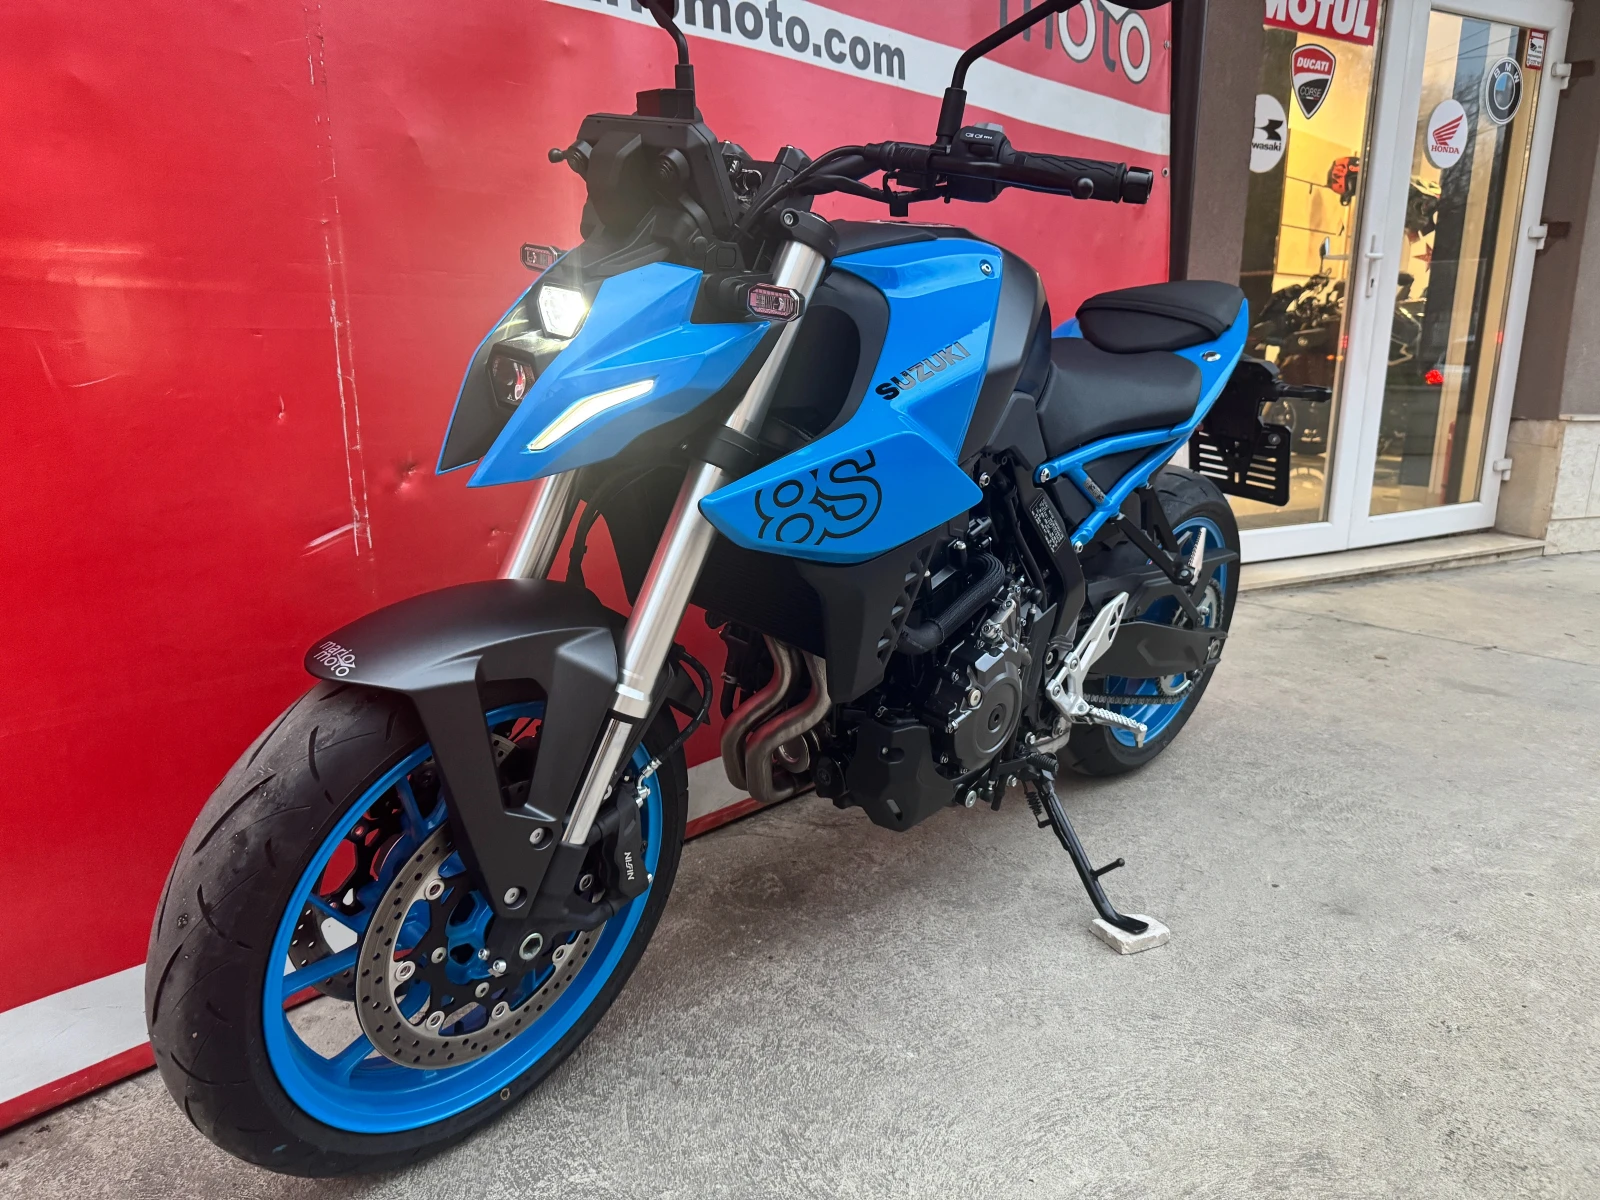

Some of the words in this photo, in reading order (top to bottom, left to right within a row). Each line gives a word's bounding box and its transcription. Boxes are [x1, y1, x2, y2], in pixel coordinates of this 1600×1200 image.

[590, 0, 906, 81] moto.com
[1297, 57, 1330, 72] DUCATI
[1493, 62, 1520, 84] BMW
[1300, 86, 1323, 98] CORSE
[1252, 141, 1282, 151] wasaki
[1431, 144, 1460, 155] HONDA
[875, 341, 971, 401] SUZUKI
[319, 640, 356, 664] mario
[313, 650, 350, 677] moto
